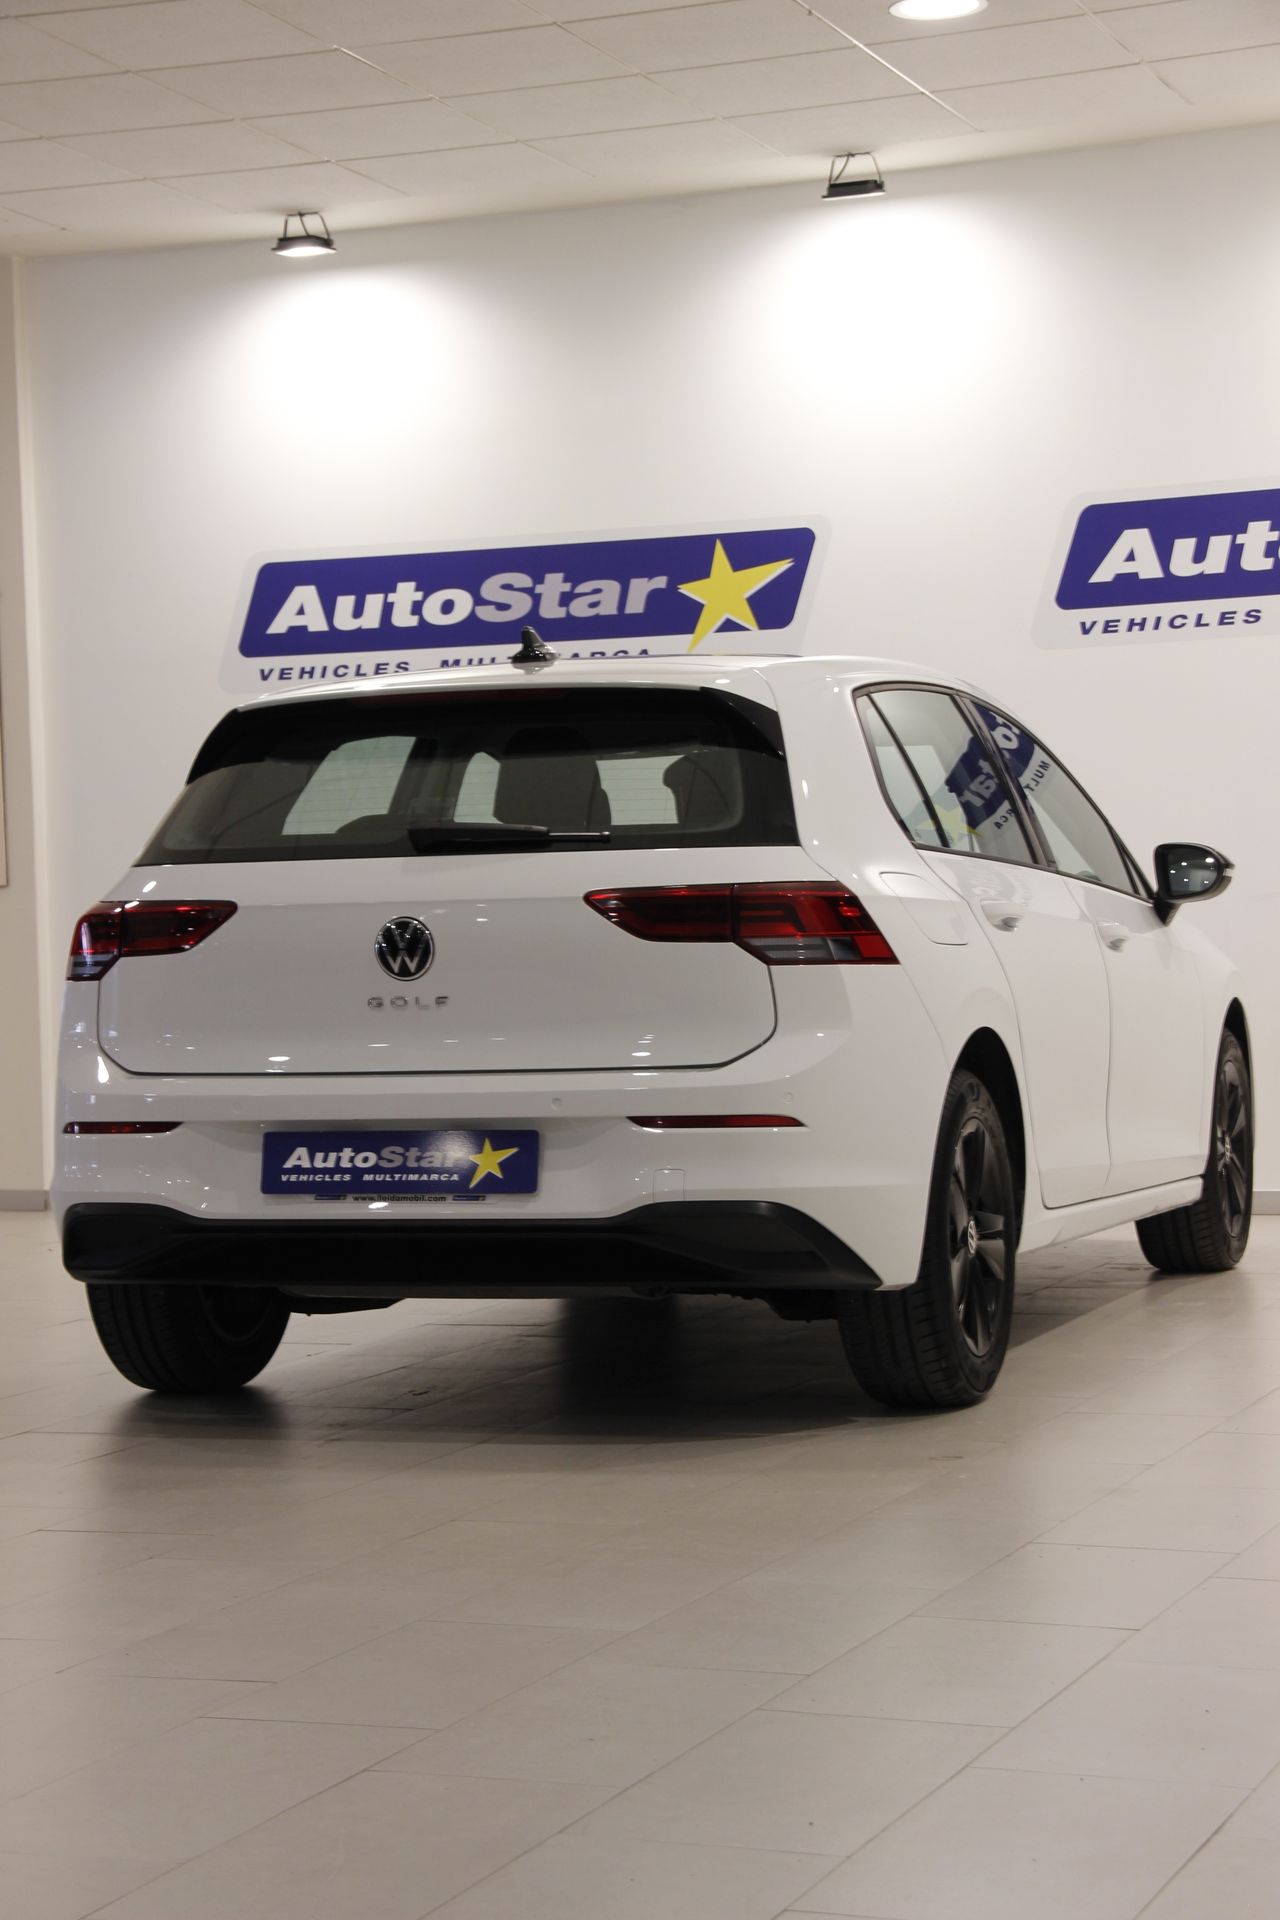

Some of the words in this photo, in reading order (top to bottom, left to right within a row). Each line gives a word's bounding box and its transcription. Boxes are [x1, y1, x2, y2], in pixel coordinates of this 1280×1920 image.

[1088, 520, 1280, 583] Aut
[265, 572, 668, 634] AutoStar
[1079, 609, 1262, 635] VEHICLES
[259, 652, 410, 681] VEHICLES
[367, 996, 449, 1009] GOLF
[282, 1146, 465, 1169] AutoStar
